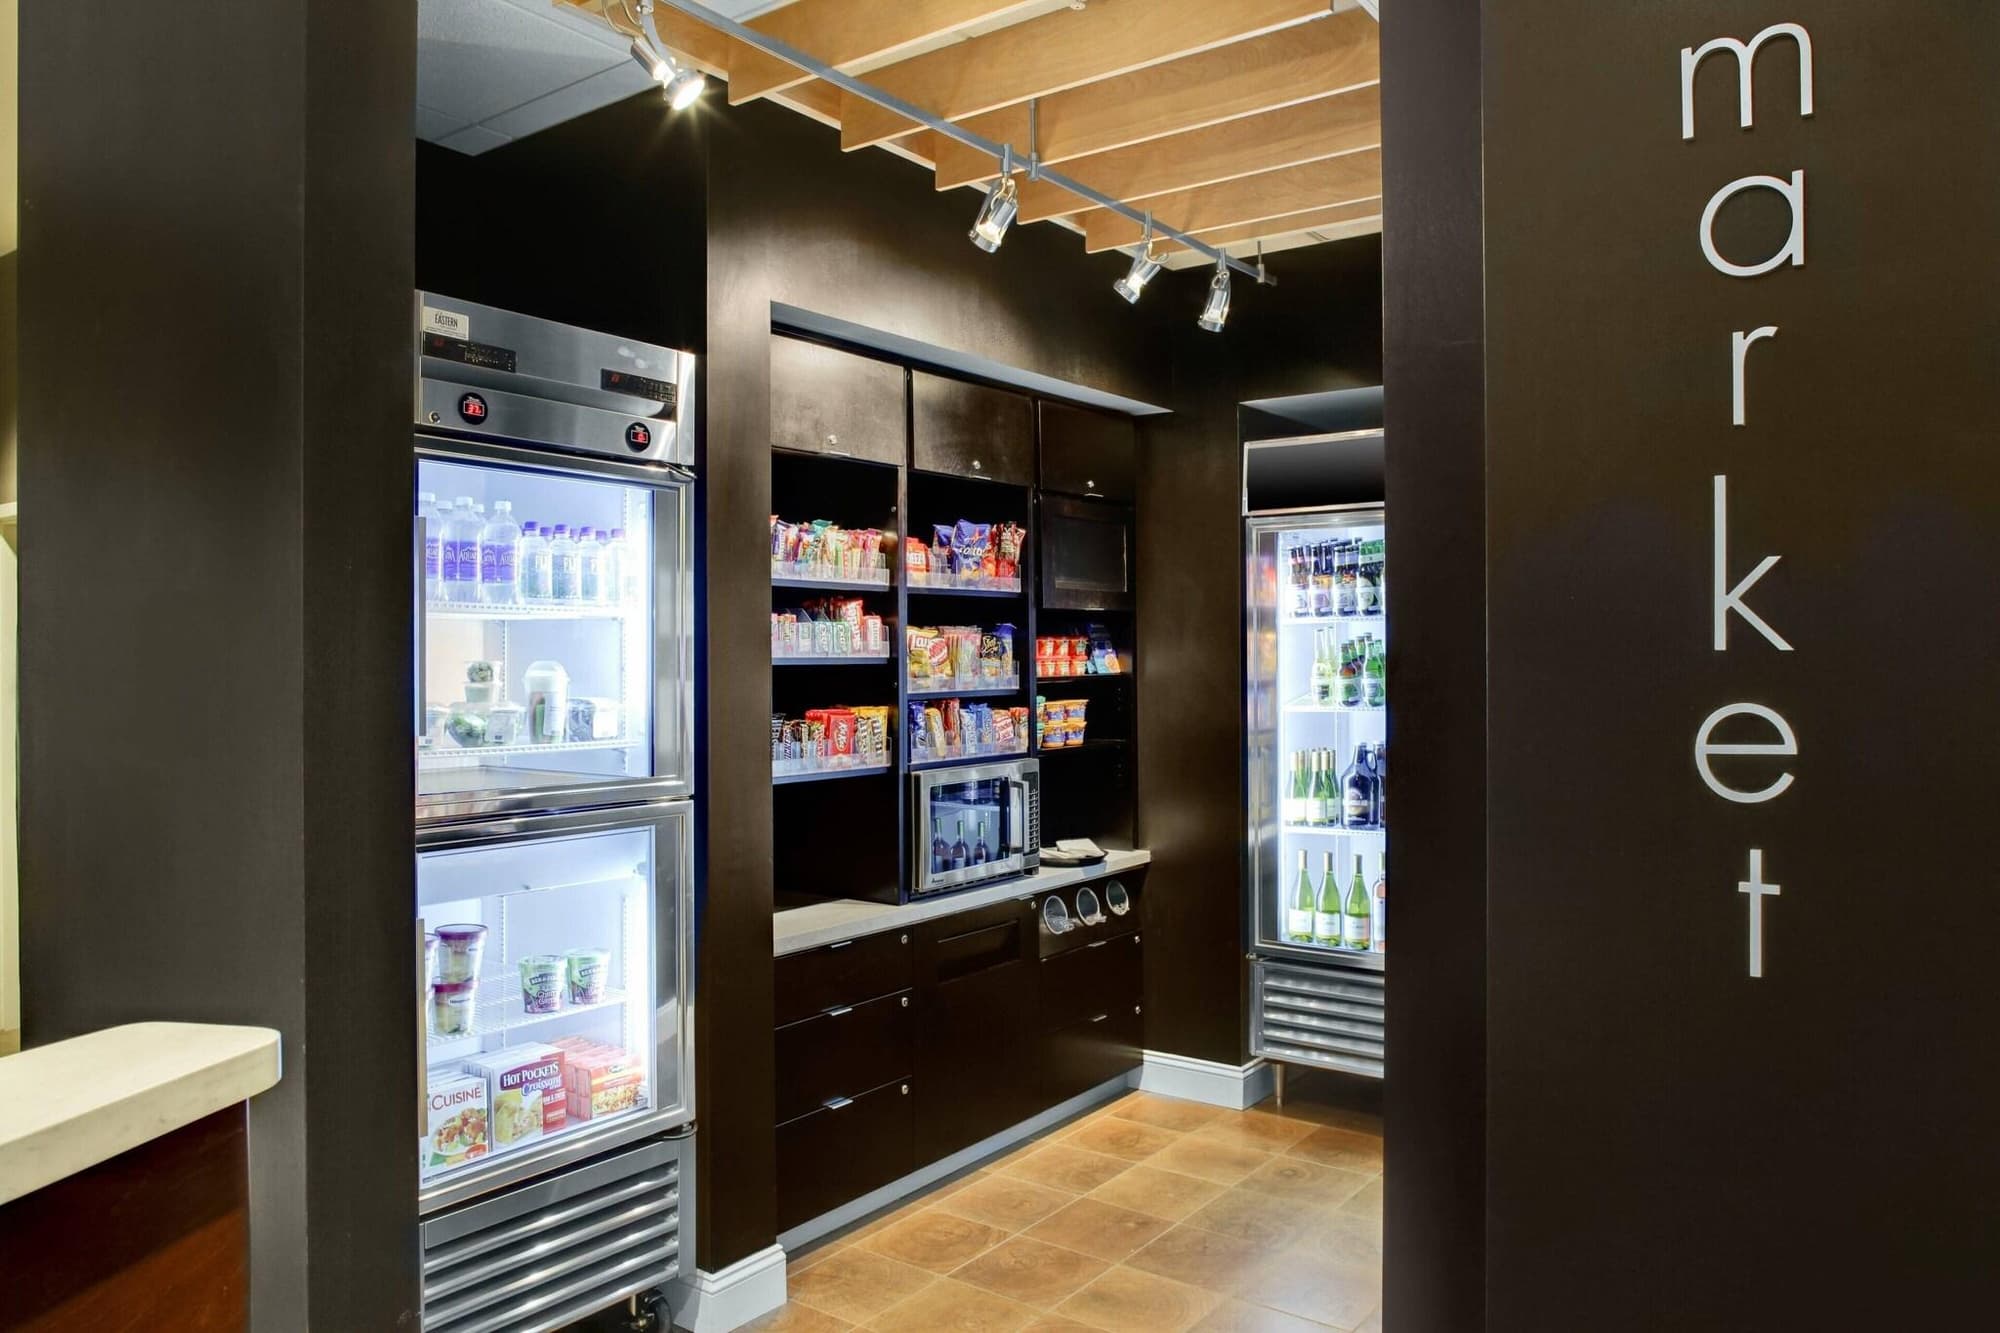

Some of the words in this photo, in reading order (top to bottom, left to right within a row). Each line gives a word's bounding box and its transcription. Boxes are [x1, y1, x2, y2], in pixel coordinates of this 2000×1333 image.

[434, 313, 458, 329] EASTERN
[1680, 22, 1814, 979] market
[503, 1073, 521, 1088] HOT
[522, 1062, 560, 1082] POCKETS
[431, 1087, 482, 1111] CUISINE
